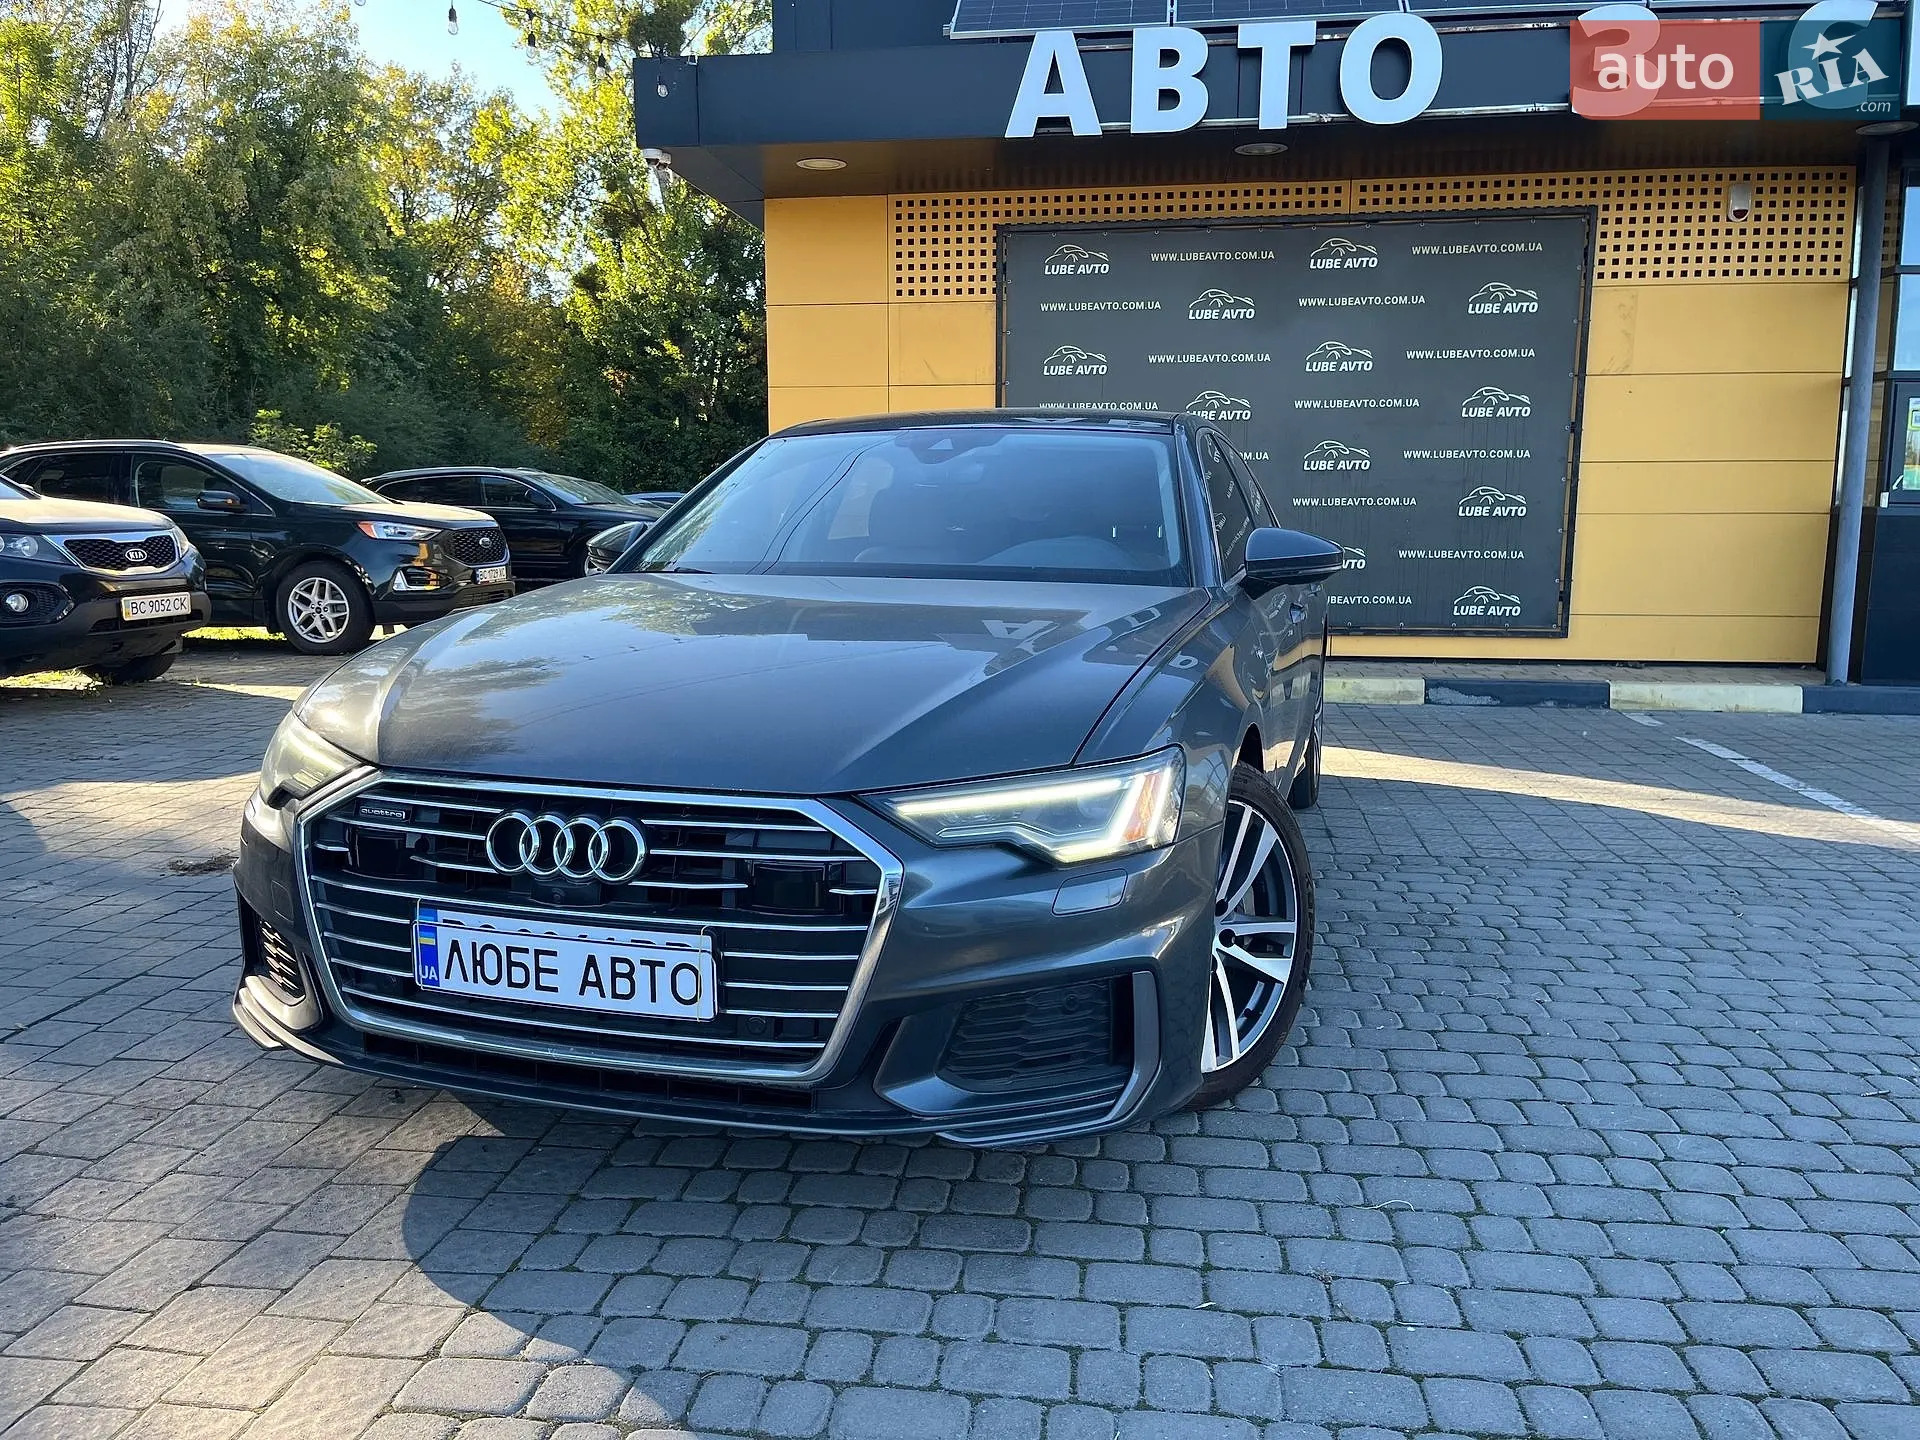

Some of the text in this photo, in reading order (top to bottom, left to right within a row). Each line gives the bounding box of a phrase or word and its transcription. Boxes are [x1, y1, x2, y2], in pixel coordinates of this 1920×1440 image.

[1004, 13, 1443, 138] АВТО
[1411, 242, 1543, 255] WWW.LUBEAVTO.COM.UA
[1151, 251, 1275, 262] WWW.LUBEAVTO.COM.UA
[1044, 263, 1110, 275] LUBE AVTO
[1310, 257, 1379, 270] LUBE AVTO
[1040, 301, 1162, 312] WWW.LUBEAVTO.COM.UA
[1298, 295, 1426, 307] WWW.LUBEAVTO.COM.UA
[1188, 308, 1256, 320] LUBE AVTO
[1467, 301, 1539, 315] LUBE AVTO
[1148, 353, 1272, 364] WWW.LUBEAVTO.COM.UA
[1406, 349, 1536, 360] WWW.LUBEAVTO.COM.UA
[1043, 364, 1108, 376] LUBE AVTO
[1305, 360, 1374, 373] LUBE AVTO
[1294, 399, 1420, 409] WWW.LUBEAVTO.COM.UA
[1218, 410, 1252, 421] AVTO
[1461, 406, 1531, 418] LUBE AVTO
[1403, 449, 1531, 459] WWW.LUBEAVTO.COM.UA
[1303, 459, 1371, 471] LUBE AVTO
[1292, 497, 1417, 507] WWW.LUBEAVTO.COM.UA
[1458, 506, 1527, 517] LUBE AVTO
[1398, 550, 1525, 560] WWW.LUBEAVTO.COM.UA
[1342, 559, 1366, 570] VTO
[130, 597, 187, 615] BC 9052 CK
[1453, 605, 1522, 617] LUBE AVTO
[360, 807, 403, 819] quattro
[419, 964, 439, 981] UA
[444, 939, 702, 1006] ЛЮБЕ АВТО
